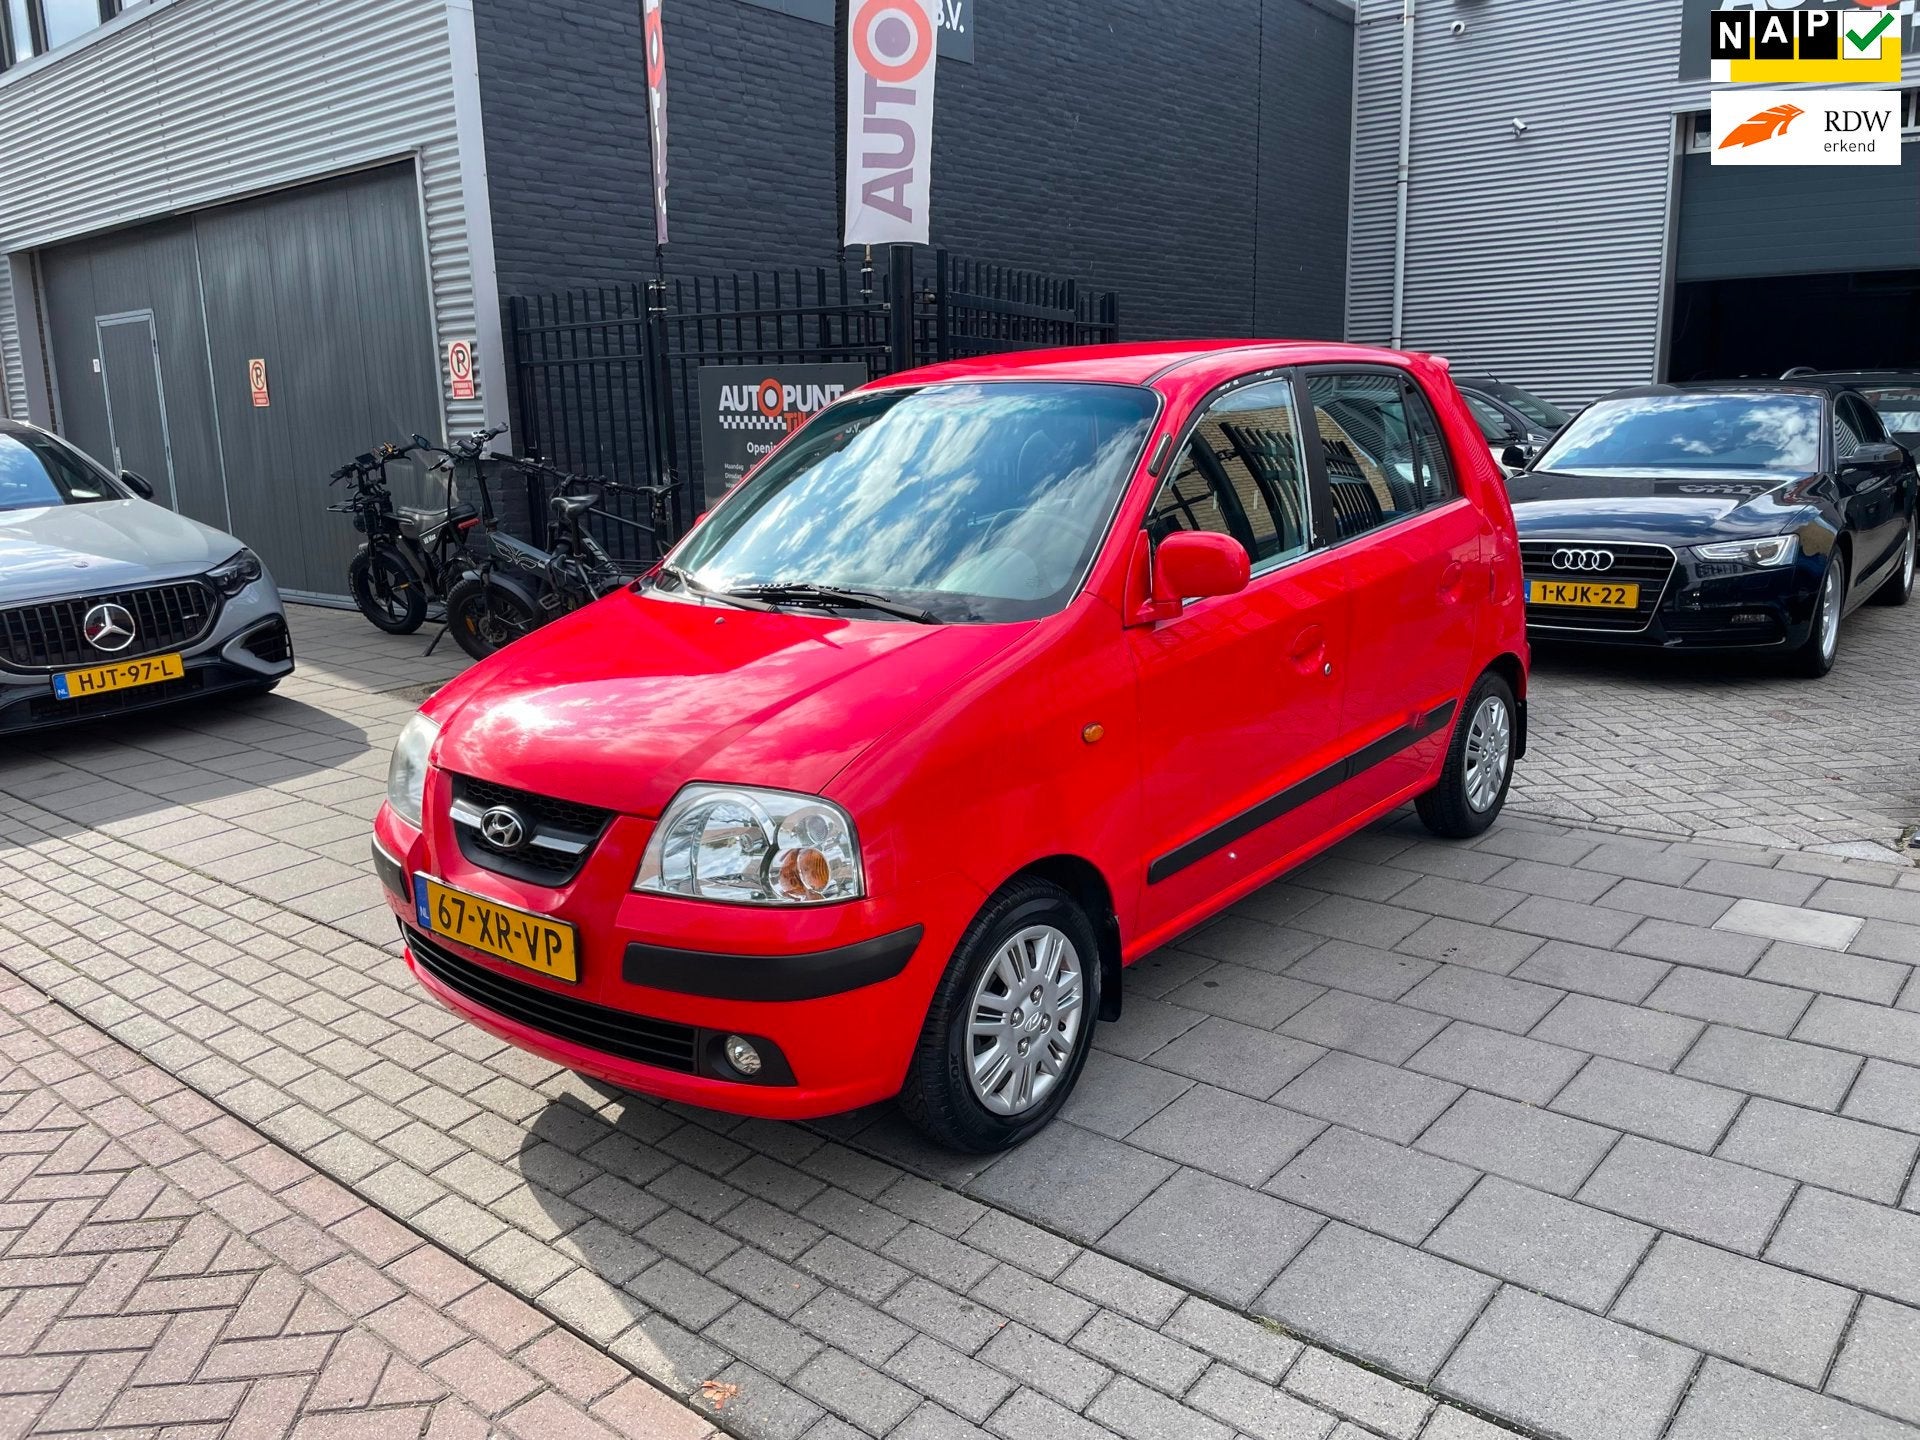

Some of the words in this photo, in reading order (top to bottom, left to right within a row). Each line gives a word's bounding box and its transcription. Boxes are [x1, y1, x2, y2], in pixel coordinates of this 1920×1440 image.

[1541, 584, 1626, 605] 1-KJK-22
[78, 660, 174, 692] HJT-97-L
[419, 905, 430, 920] NL
[438, 893, 562, 967] 67-XR-VP
